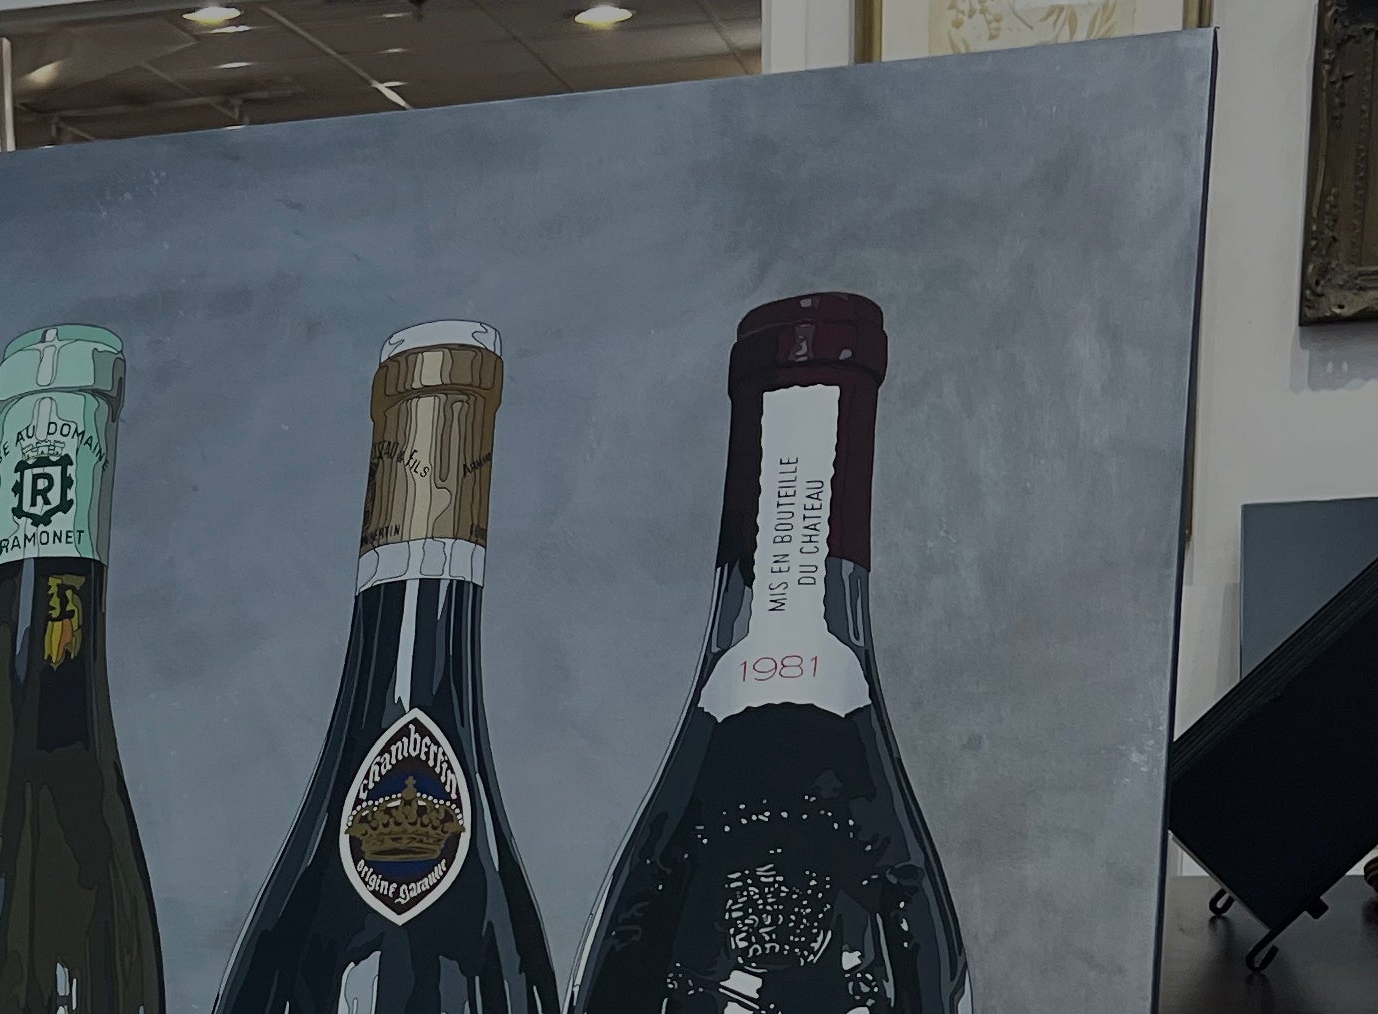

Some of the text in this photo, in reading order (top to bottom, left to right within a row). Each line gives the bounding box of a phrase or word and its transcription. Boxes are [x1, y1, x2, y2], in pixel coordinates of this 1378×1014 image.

[15, 424, 35, 446] AU
[47, 421, 109, 471] DOMAINE
[30, 472, 54, 507] R
[0, 529, 85, 554] RAMONET
[768, 456, 799, 612] MIS EN BOUTEILLE
[797, 479, 825, 586] DU CHATEAU
[740, 655, 818, 682] 1981
